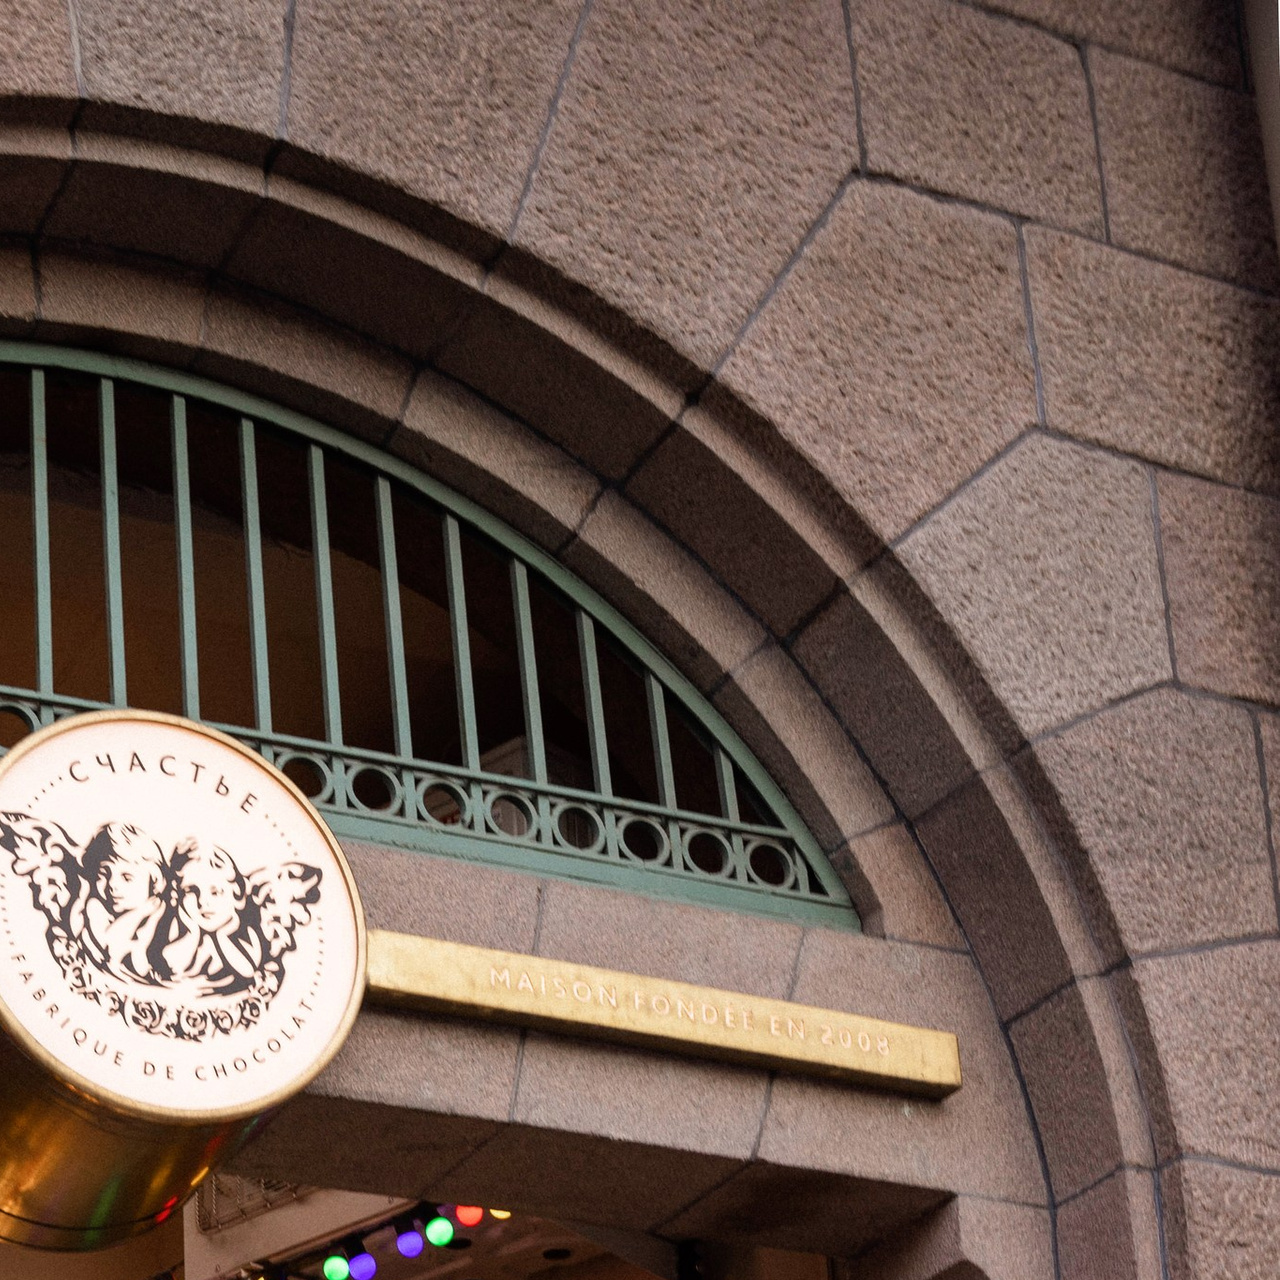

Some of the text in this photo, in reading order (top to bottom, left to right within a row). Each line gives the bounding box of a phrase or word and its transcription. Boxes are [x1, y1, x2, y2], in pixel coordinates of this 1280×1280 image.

[69, 751, 258, 813] СЧАСТЬЕ
[11, 953, 315, 1082] FABRIQUE DE CHOCOLAT
[489, 965, 619, 1009] MAISON
[770, 1013, 807, 1041] EN
[820, 1023, 891, 1057] 2008
